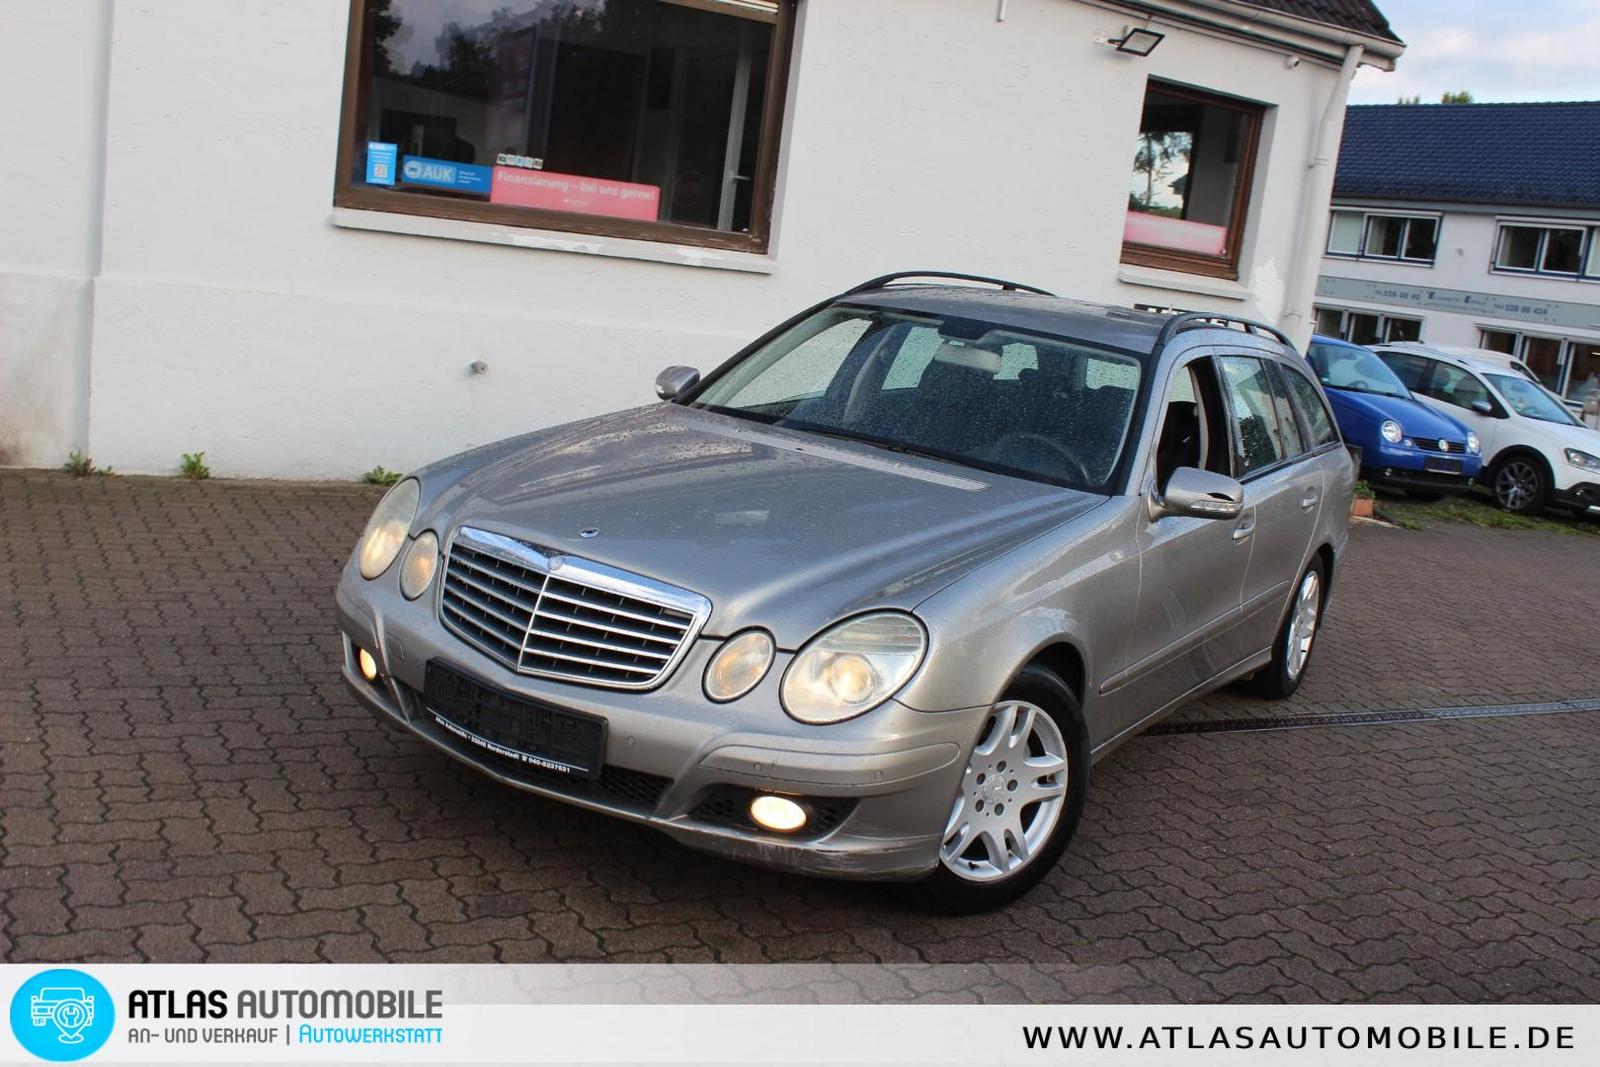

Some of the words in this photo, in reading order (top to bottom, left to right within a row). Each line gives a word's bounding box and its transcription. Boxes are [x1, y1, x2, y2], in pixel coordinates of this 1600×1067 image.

[423, 165, 452, 182] AUK
[497, 171, 568, 192] Finanzierung
[580, 181, 597, 195] bei
[600, 185, 618, 196] uns
[620, 187, 655, 200] gerne!
